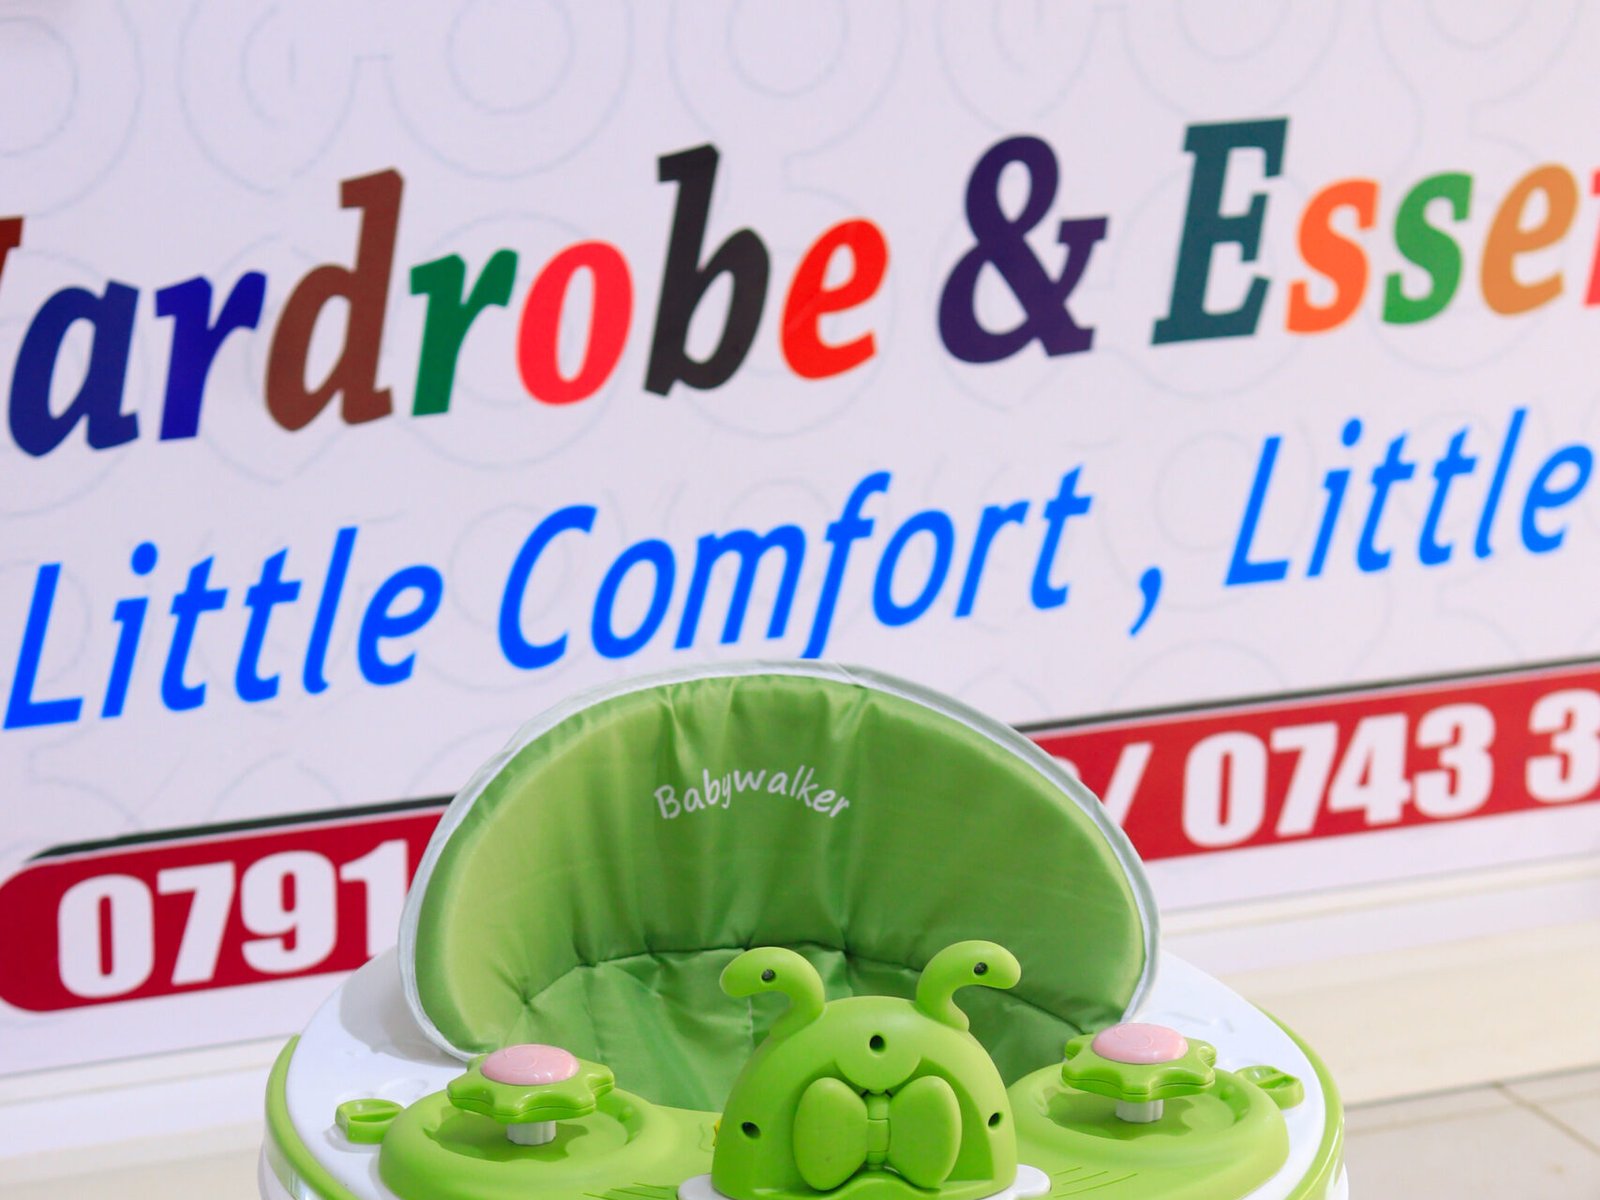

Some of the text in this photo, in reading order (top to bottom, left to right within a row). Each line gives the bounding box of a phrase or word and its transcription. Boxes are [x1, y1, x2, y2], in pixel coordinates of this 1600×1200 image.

[0, 116, 1600, 458] ardrobe & Esse
[2, 525, 445, 730] Little
[498, 464, 1092, 670] Comfort
[1223, 407, 1594, 588] Little
[57, 838, 409, 999] 0791
[1181, 702, 1497, 849] 0743
[653, 764, 850, 820] Babywalker
